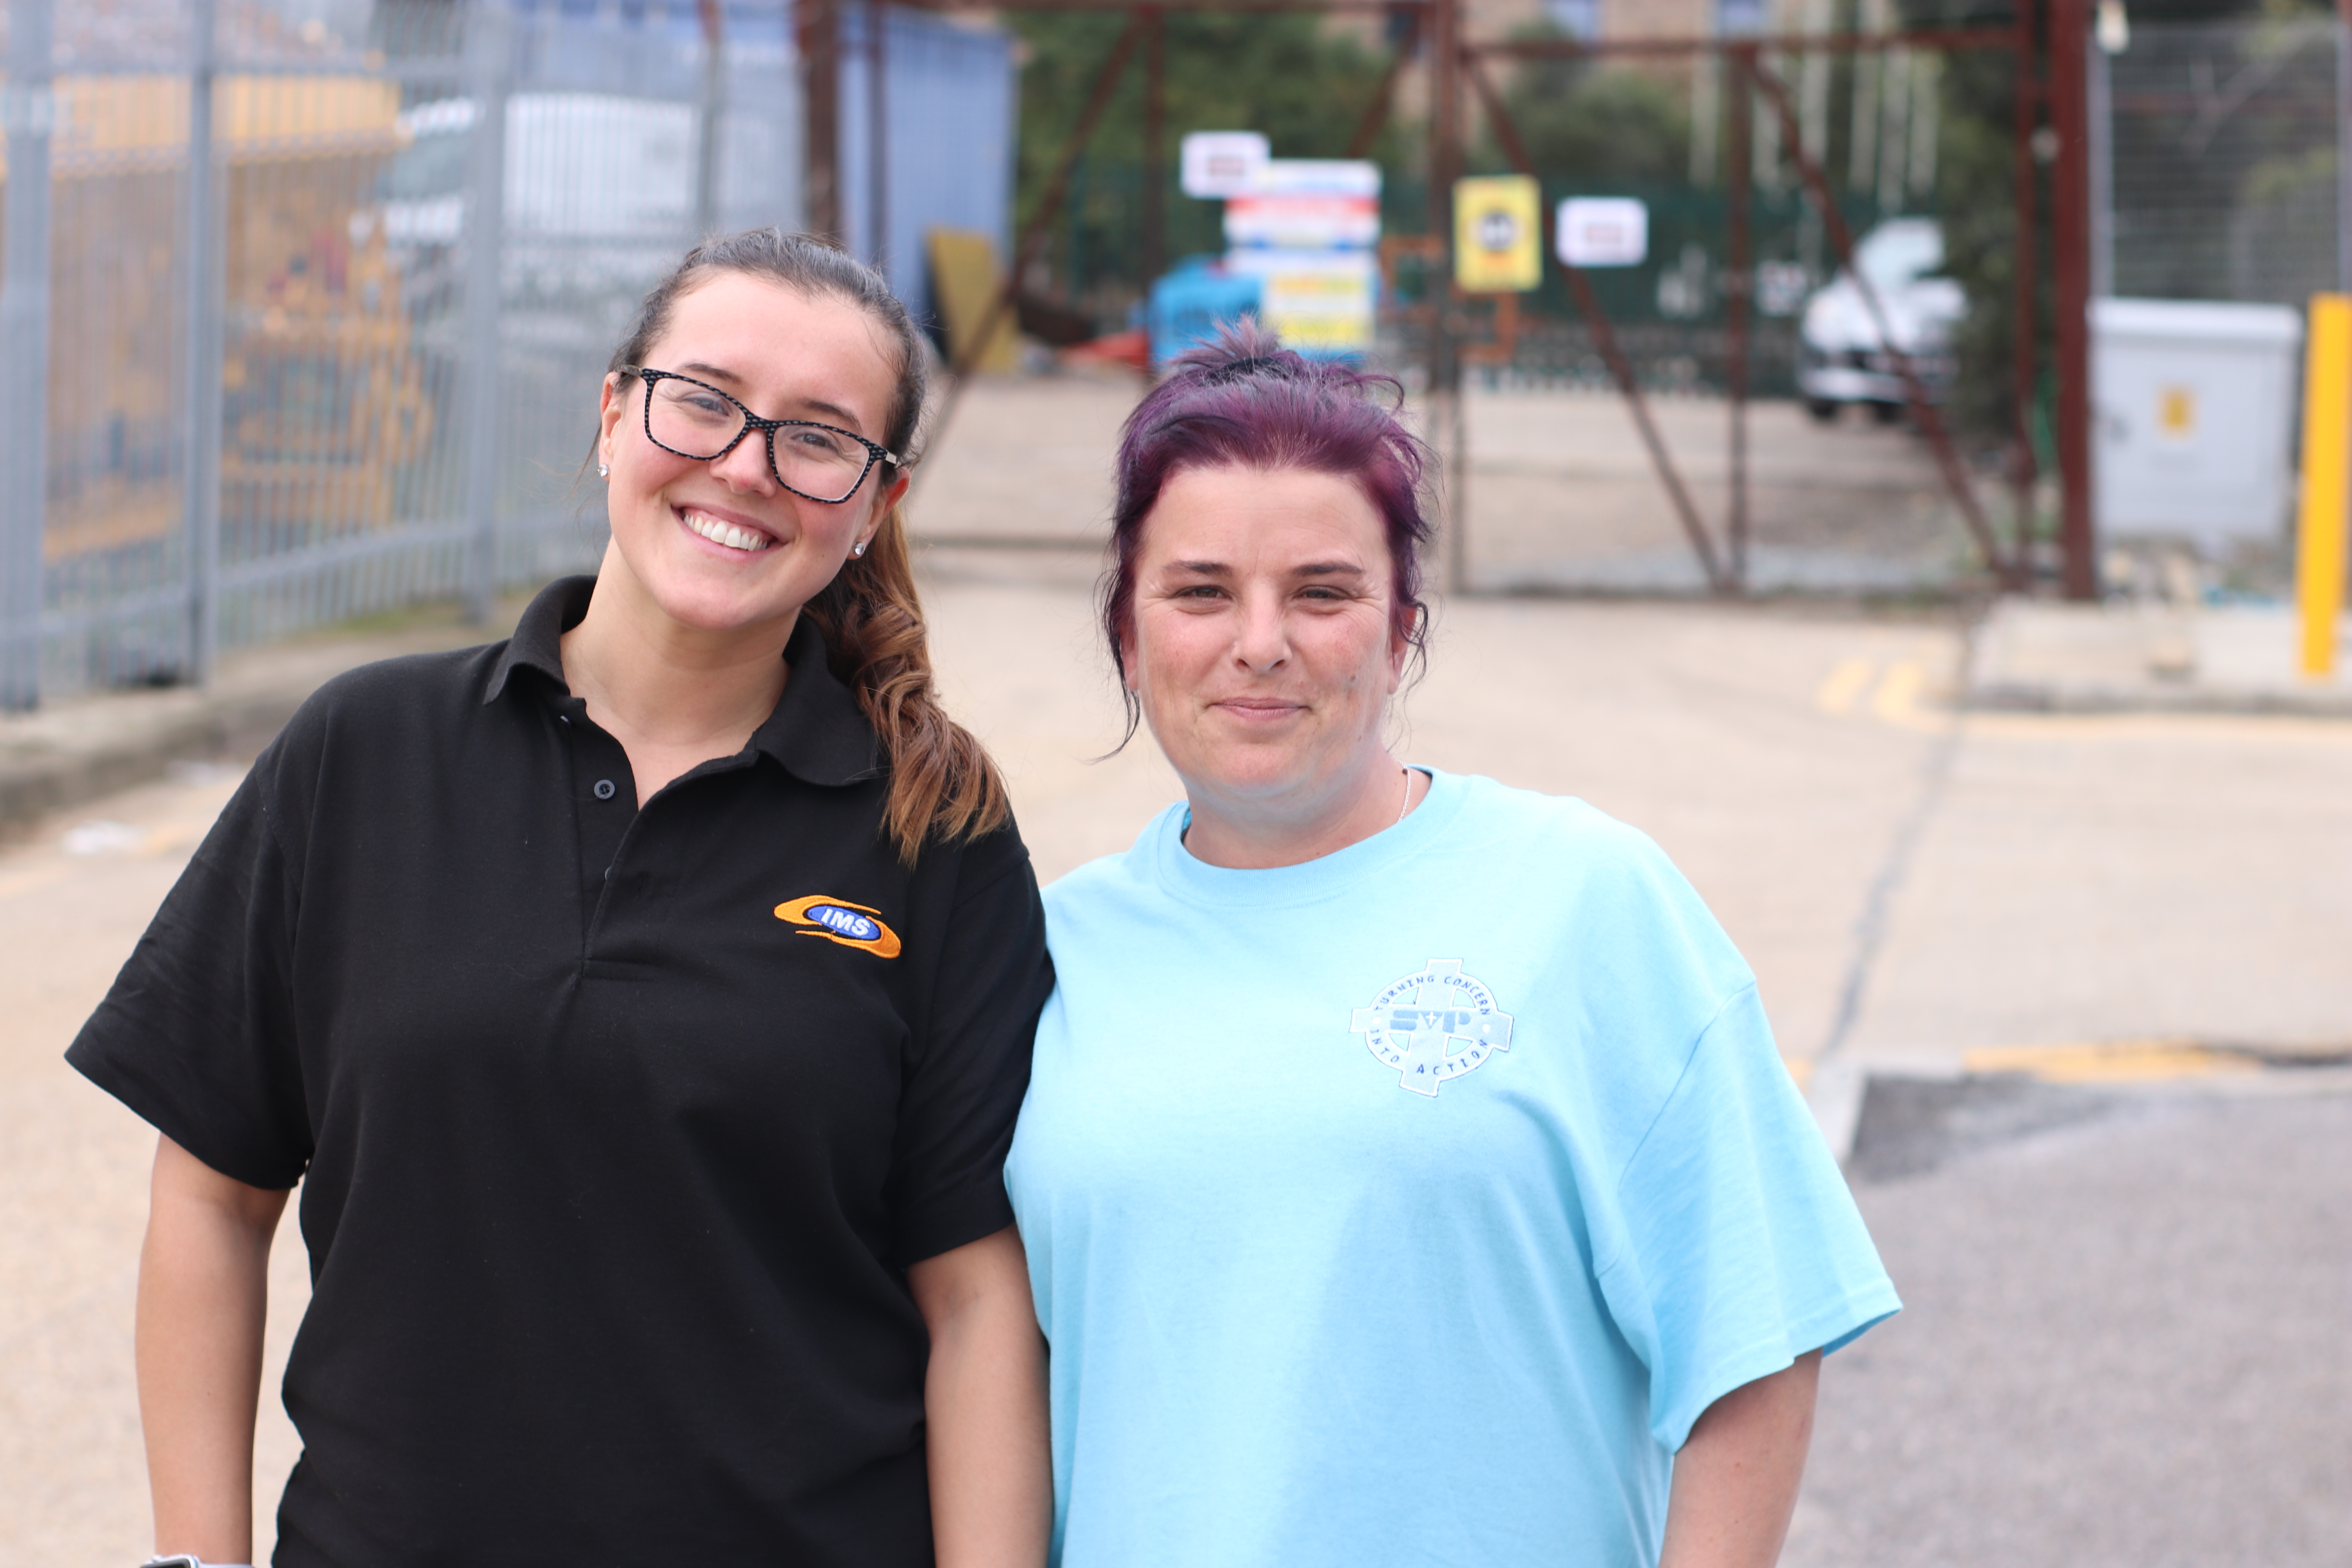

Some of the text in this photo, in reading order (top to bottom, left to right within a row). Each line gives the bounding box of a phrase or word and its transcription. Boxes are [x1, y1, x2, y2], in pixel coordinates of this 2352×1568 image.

[822, 909, 870, 935] IMS
[1374, 975, 1490, 1015] TURNING CONCERN
[1370, 1029, 1488, 1075] INTO ACTION
